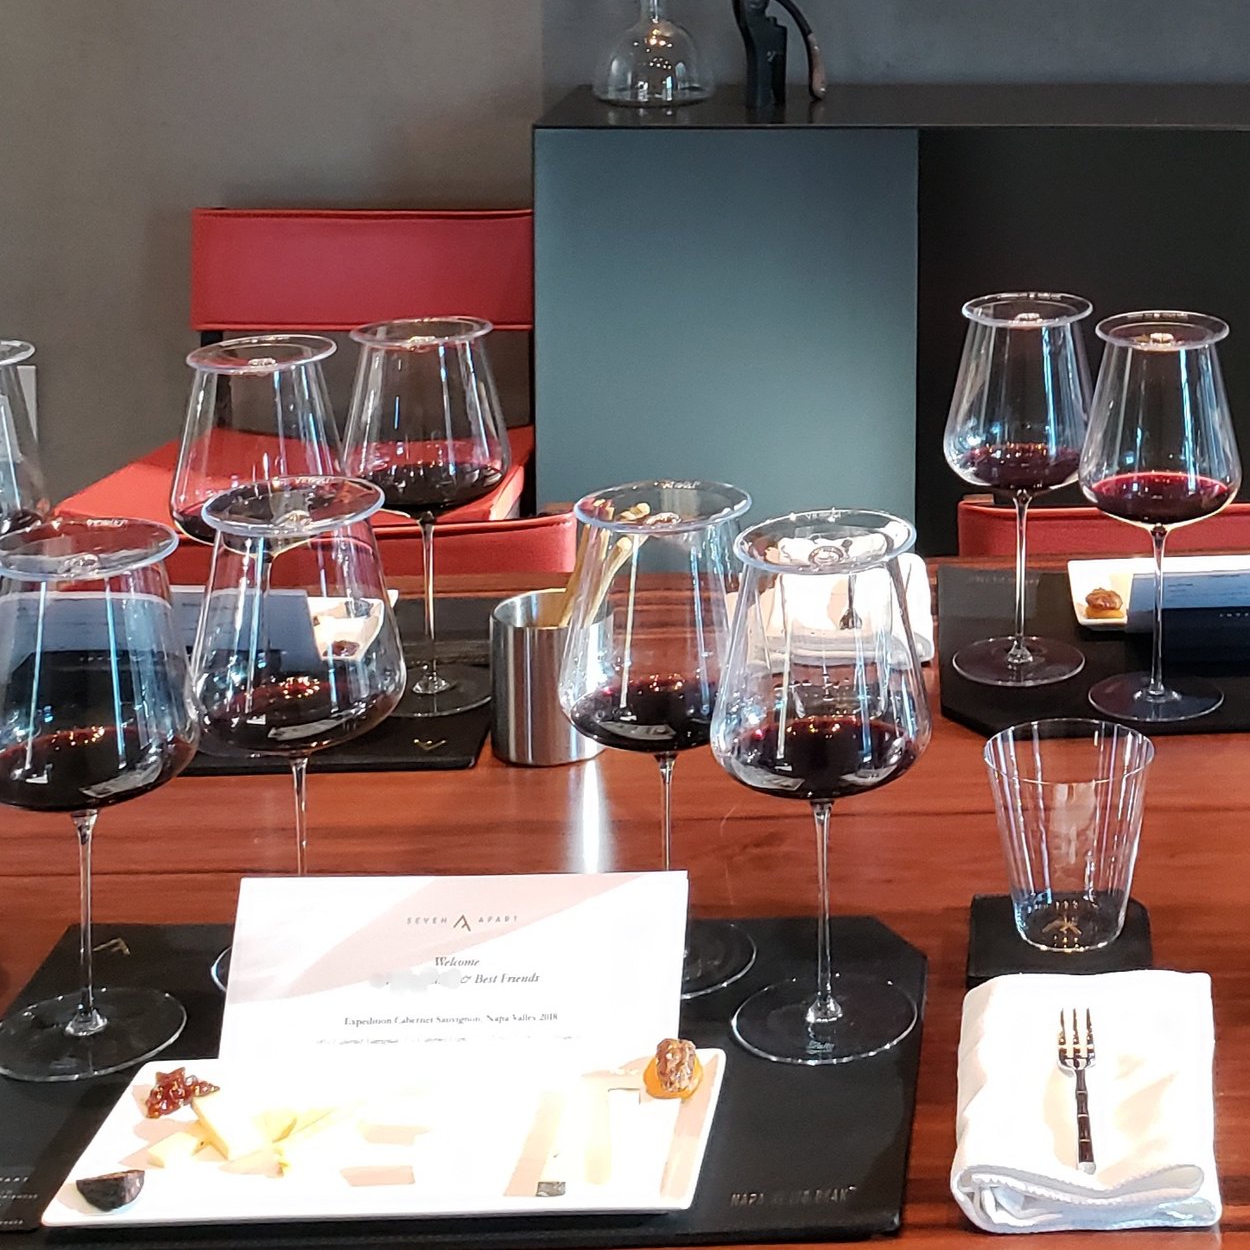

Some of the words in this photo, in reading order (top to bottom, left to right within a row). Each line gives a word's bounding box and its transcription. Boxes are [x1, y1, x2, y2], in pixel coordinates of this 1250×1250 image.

[406, 916, 447, 925] SEVEN
[478, 915, 518, 923] APART
[435, 956, 480, 967] Welcome
[474, 973, 498, 984] Best
[501, 972, 541, 983] Friends
[344, 1016, 392, 1028] Expedition
[394, 1015, 434, 1025] Cabernet
[539, 1012, 559, 1022] 2018
